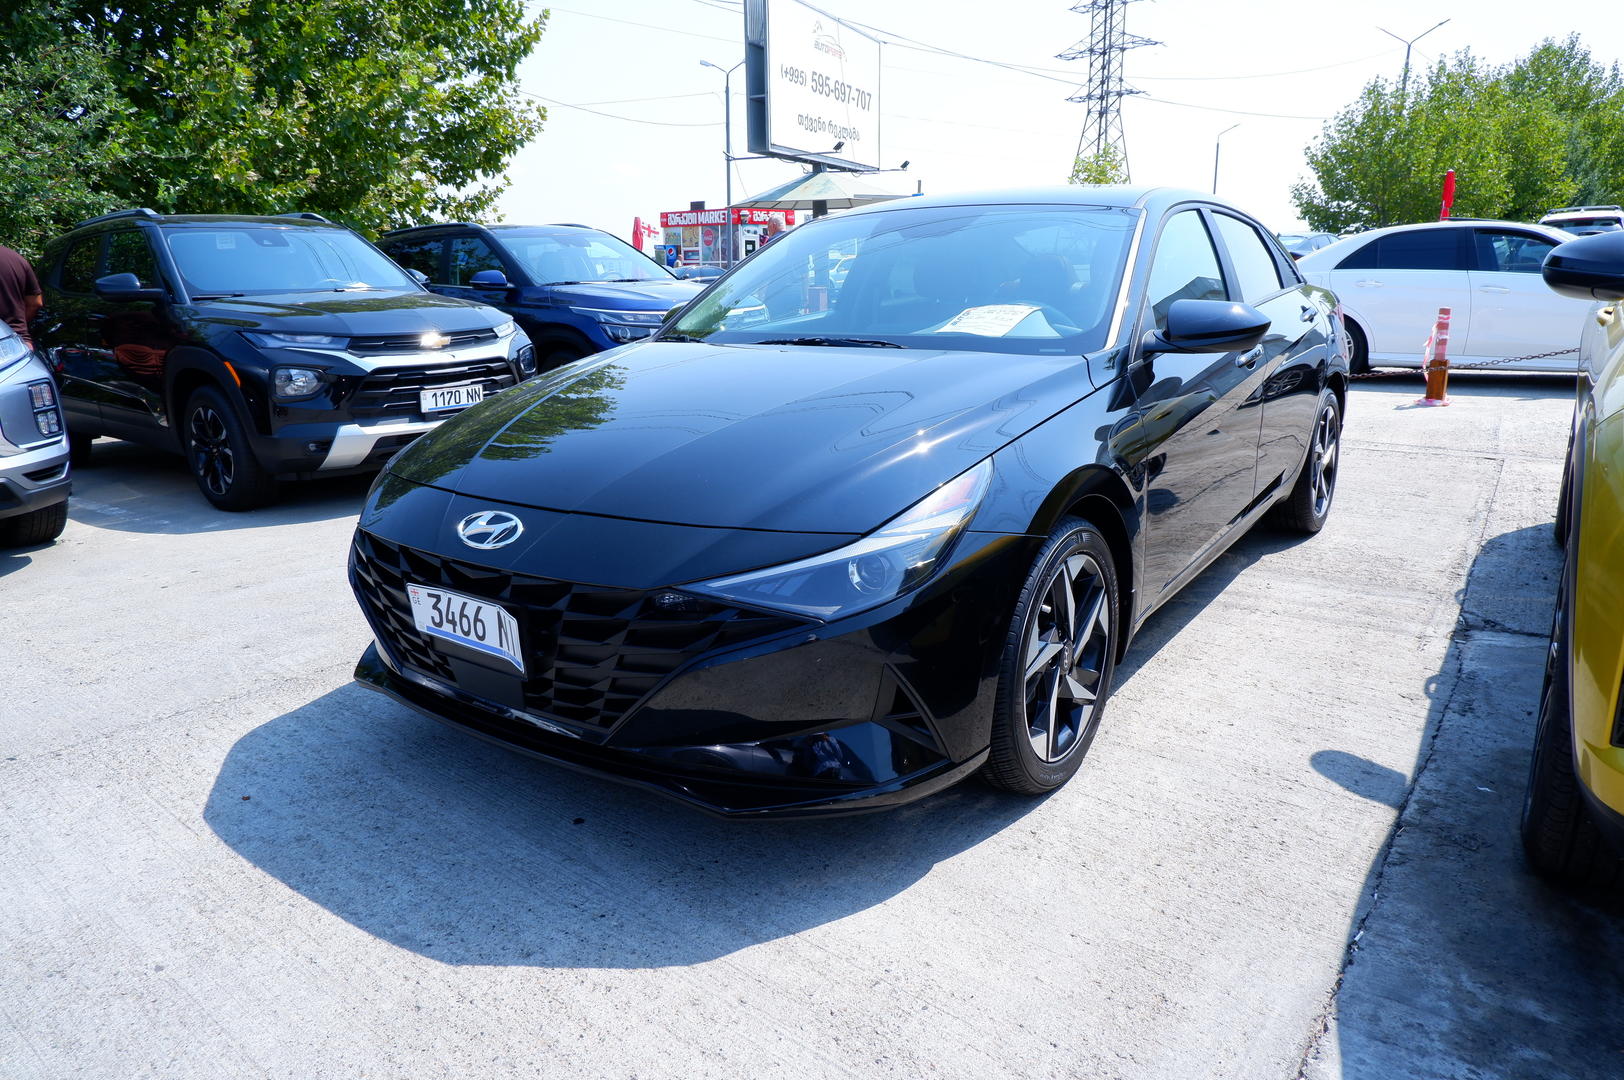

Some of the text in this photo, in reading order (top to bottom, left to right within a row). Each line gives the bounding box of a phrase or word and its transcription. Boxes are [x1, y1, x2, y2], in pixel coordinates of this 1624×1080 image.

[780, 64, 872, 112] (+995) 595-697-707
[431, 389, 462, 407] 1170
[466, 387, 481, 403] NN
[427, 592, 487, 642] 3466
